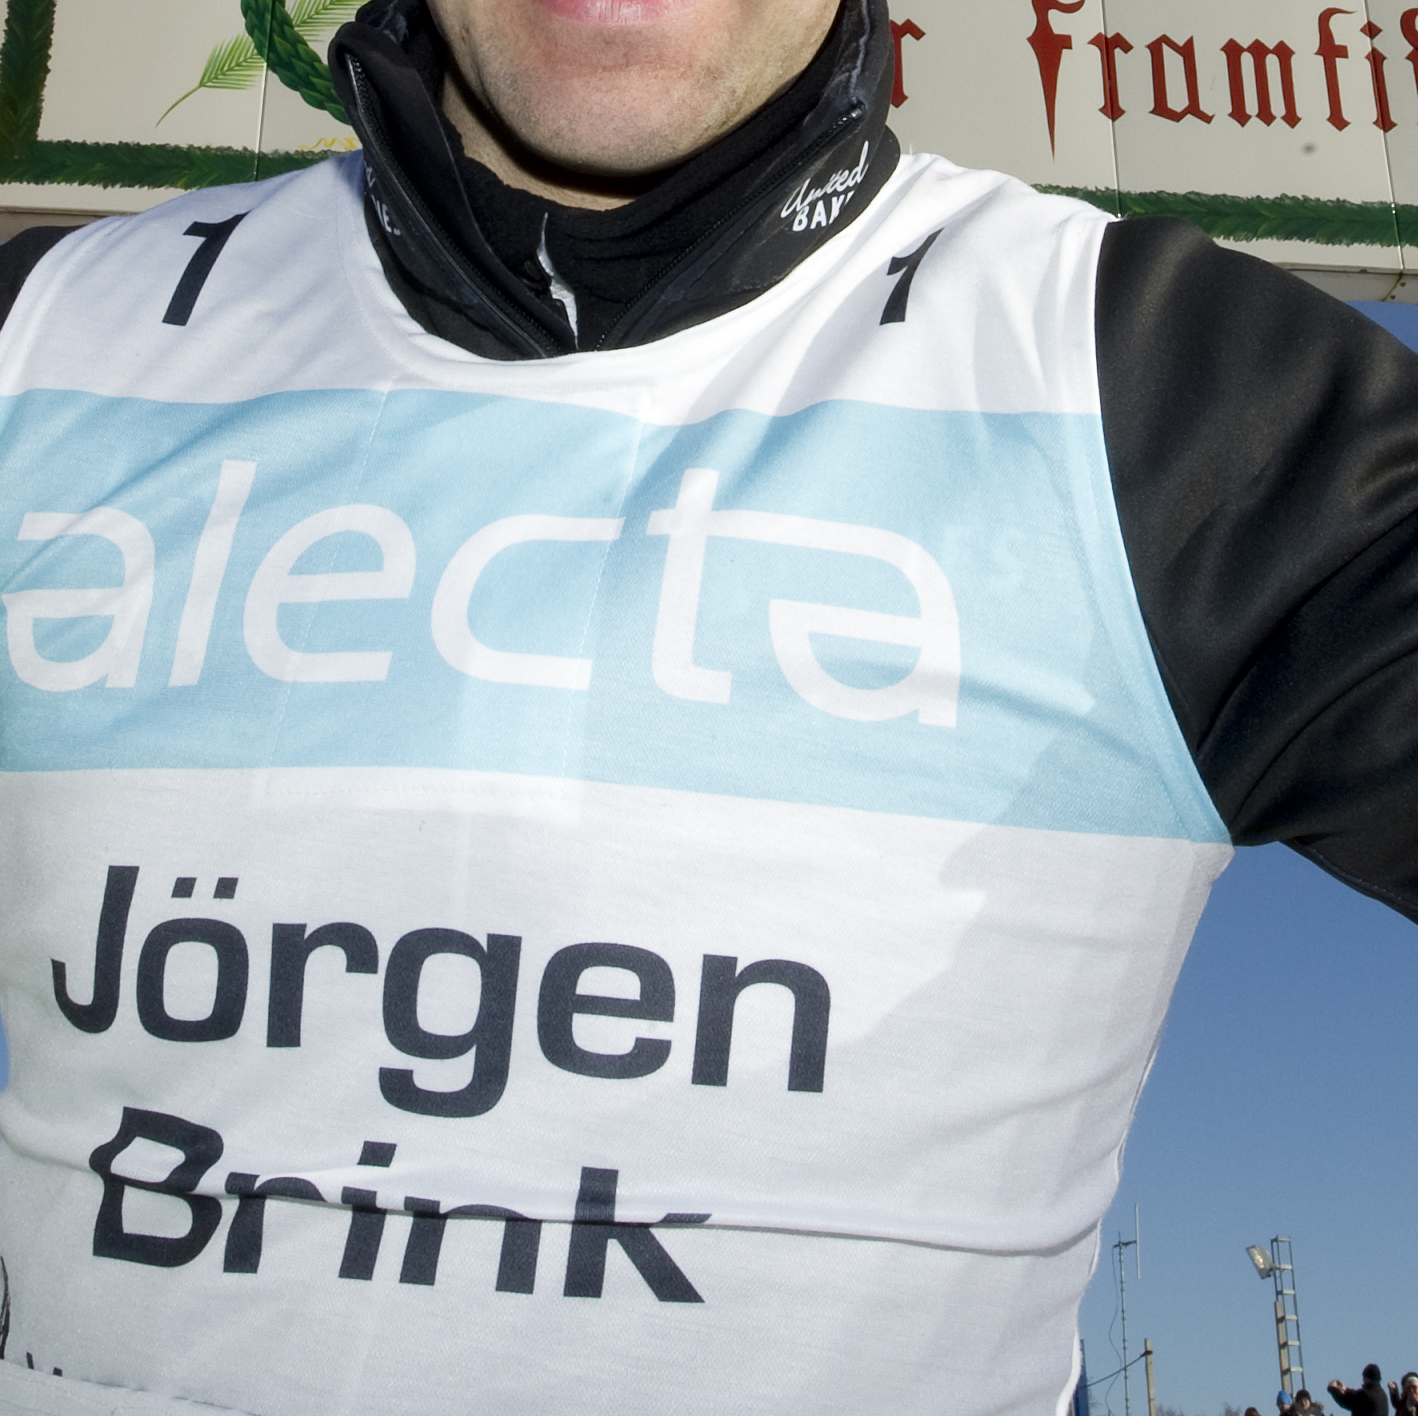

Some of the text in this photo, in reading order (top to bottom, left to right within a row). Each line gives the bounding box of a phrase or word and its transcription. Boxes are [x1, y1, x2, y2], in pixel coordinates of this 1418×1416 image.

[161, 211, 250, 326] 1
[879, 228, 945, 326] 1
[2, 460, 963, 728] alecta
[50, 865, 832, 1119] Jörgen
[87, 1105, 713, 1303] Brink
